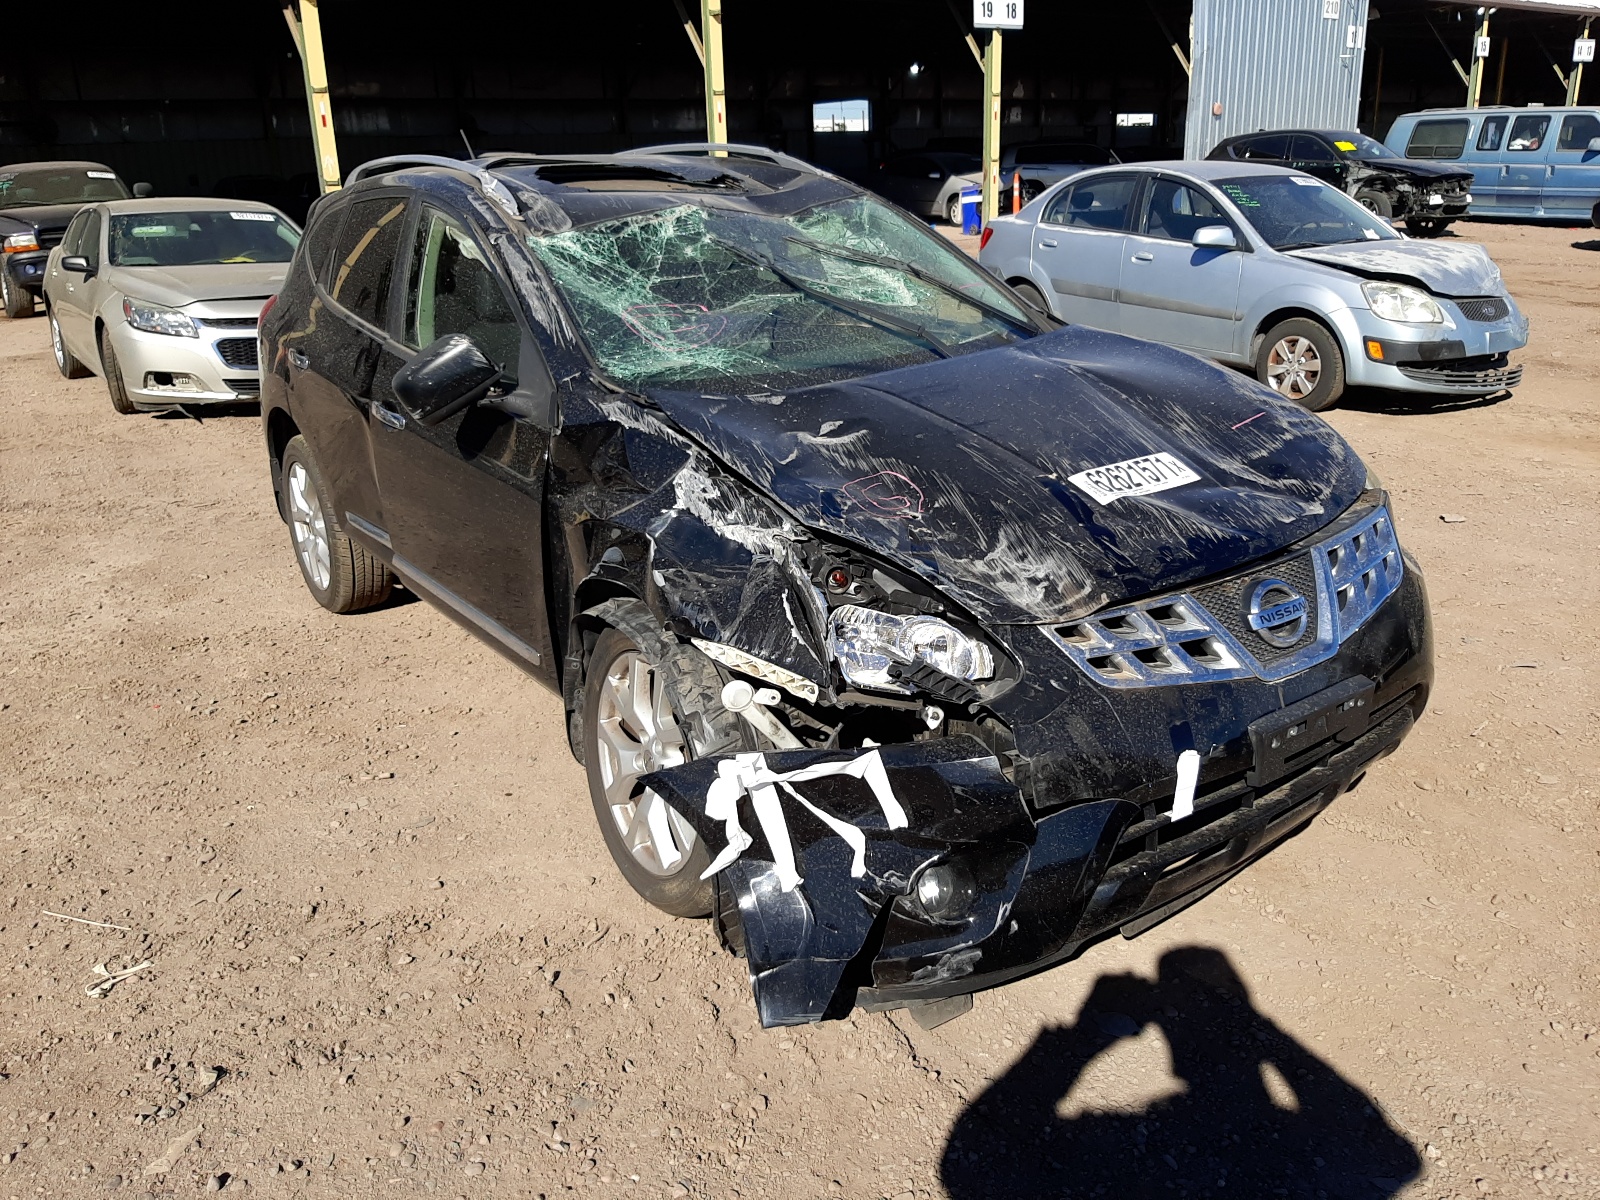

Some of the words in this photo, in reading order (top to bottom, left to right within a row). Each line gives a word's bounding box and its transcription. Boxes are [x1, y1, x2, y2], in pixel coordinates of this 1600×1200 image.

[981, 1, 993, 18] 19
[1006, 2, 1017, 19] 18
[1325, 0, 1339, 15] 210
[1480, 41, 1487, 53] 15
[1085, 456, 1179, 492] 62621571
[1259, 600, 1307, 625] NISSAN
